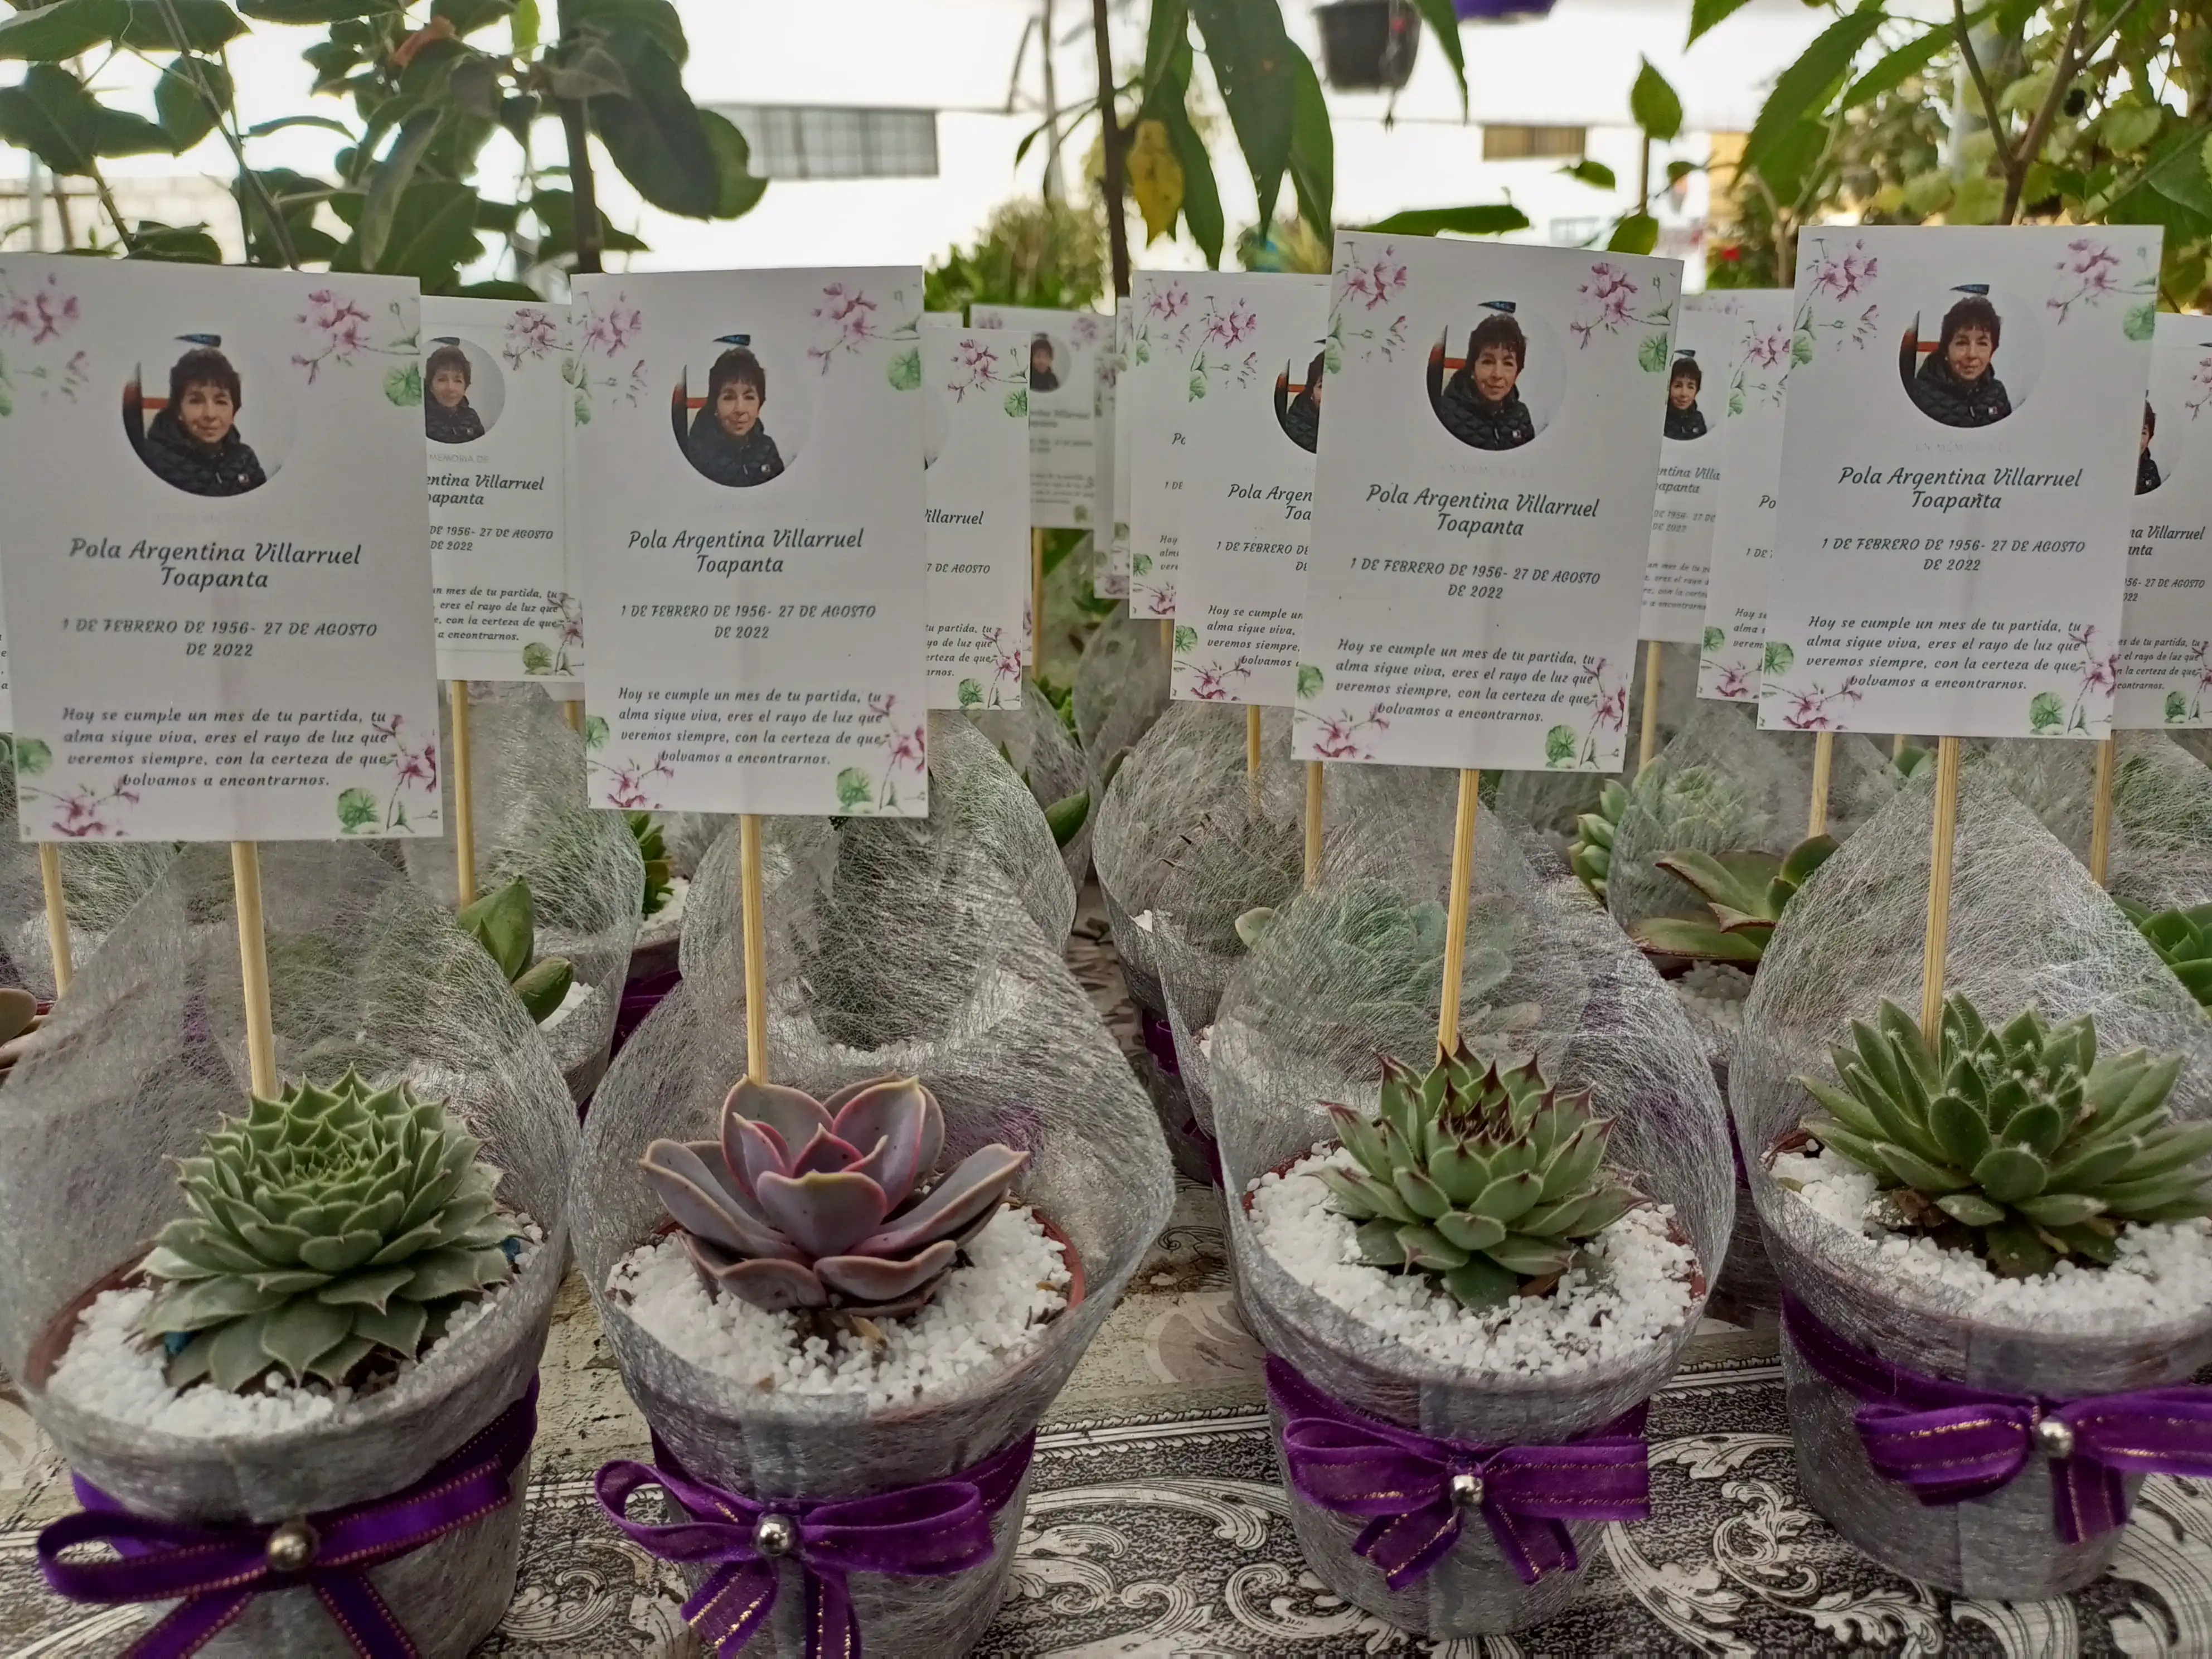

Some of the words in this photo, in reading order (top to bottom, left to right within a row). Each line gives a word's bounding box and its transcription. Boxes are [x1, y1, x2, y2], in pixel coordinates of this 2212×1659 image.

[476, 474, 545, 490] Villarruel
[1172, 481, 1183, 489] DE
[1838, 465, 1882, 484] Pola
[1886, 467, 1986, 490] Argentina
[1993, 467, 2083, 487] Villarruel
[1228, 483, 1262, 499] Pola
[1366, 484, 1409, 504] Pola
[1413, 488, 1509, 512] Argentina
[1516, 494, 1600, 517] Villarruel
[430, 526, 443, 535] DE
[479, 528, 493, 537] 27
[496, 528, 510, 537] DE
[512, 529, 554, 539] AGOSTO
[1437, 513, 1524, 538] Toapanta
[2148, 525, 2205, 540] Villarruel
[430, 541, 444, 549] DE
[446, 541, 473, 551] 2022
[628, 529, 667, 549] Pola
[672, 530, 765, 554] Argentina
[773, 527, 864, 547] Villarruel
[1160, 535, 1177, 545] Hoy
[1822, 538, 1828, 549] 1
[1833, 538, 1852, 550] DE
[1856, 538, 1920, 550] FEBRERO
[1925, 539, 1943, 551] DE
[1991, 540, 2007, 551] 27
[2011, 540, 2029, 552] DE
[2032, 541, 2085, 552] AGOSTO
[69, 537, 121, 558] Pola
[128, 540, 245, 566] Argentina
[255, 542, 362, 564] Villarruel
[1225, 542, 1240, 551] DE
[1243, 542, 1292, 554] FEBRERO
[1754, 549, 1768, 558] DE
[697, 555, 783, 579] Toapanta
[935, 563, 949, 573] DE
[951, 564, 990, 574] AGOSTO
[1351, 557, 1357, 569] 1
[1361, 558, 1380, 570] DE
[1384, 560, 1444, 574] FEBRERO
[1449, 564, 1468, 576] DE
[1513, 567, 1529, 580] 27
[1532, 569, 1549, 581] DE
[1551, 570, 1600, 584] AGOSTO
[1923, 559, 1942, 570] DE
[1947, 559, 1981, 571] 2022
[161, 566, 268, 593] Toapanta
[2145, 579, 2156, 587] 27
[2157, 579, 2170, 588] DE
[2171, 579, 2205, 588] AGOSTO
[1448, 584, 1466, 596] DE
[1470, 585, 1503, 599] 2022
[465, 601, 474, 609] el
[478, 604, 501, 613] rayo
[506, 602, 517, 611] de
[521, 603, 536, 612] luz
[540, 605, 558, 614] que
[622, 605, 626, 616] 1
[631, 605, 647, 617] DE
[652, 605, 709, 617] FEBRERO
[714, 605, 730, 617] DE
[778, 605, 794, 617] 27
[799, 605, 817, 618] DE
[821, 605, 876, 618] AGOSTO
[1208, 605, 1229, 618] Hoy
[1249, 608, 1287, 620] cumple
[1735, 608, 1755, 620] Hoy
[63, 618, 69, 629] 1
[76, 619, 98, 632] DE
[104, 619, 177, 633] FEBRERO
[185, 620, 205, 634] DE
[264, 622, 283, 634] 27
[289, 622, 309, 635] DE
[314, 623, 377, 637] AGOSTO
[715, 626, 731, 638] DE
[736, 627, 769, 638] 2022
[1734, 623, 1758, 633] alma
[1808, 615, 1836, 631] Hoy
[1861, 617, 1910, 632] cumple
[1971, 618, 1986, 630] de
[1992, 620, 2005, 630] tu
[2008, 619, 2061, 634] partida,
[2069, 622, 2081, 631] tu
[186, 642, 207, 656] DE
[213, 643, 253, 657] 2022
[1807, 635, 1841, 647] alma
[1846, 636, 1882, 651] sigue
[1888, 637, 1920, 649] viva,
[1962, 637, 1975, 649] el
[1978, 642, 2008, 653] rayo
[2014, 638, 2028, 650] de
[2034, 638, 2053, 651] luz
[2058, 642, 2080, 654] que
[1807, 658, 1864, 666] veremos
[1869, 656, 1927, 671] siempre,
[1964, 657, 1976, 669] la
[1982, 660, 2029, 670] certeza
[2034, 658, 2049, 670] de
[1935, 680, 2026, 689] encontrarnos.
[618, 687, 642, 703] Hoy
[648, 691, 659, 700] se
[665, 688, 709, 704] cumple
[715, 692, 729, 701] un
[735, 692, 760, 701] mes
[766, 688, 781, 701] de
[788, 692, 801, 701] tu
[805, 689, 860, 706] partida,
[868, 692, 881, 702] tu
[619, 707, 649, 720] alma
[654, 709, 686, 724] sigue
[691, 709, 721, 722] viva,
[727, 713, 753, 722] eres
[759, 710, 771, 722] el
[776, 714, 806, 726] rayo
[812, 710, 827, 722] de
[833, 710, 853, 723] luz
[858, 714, 882, 726] que
[621, 731, 671, 740] veremos
[677, 730, 729, 745] siempre,
[735, 734, 757, 743] con
[764, 730, 775, 743] la
[782, 734, 830, 743] certeza
[836, 731, 851, 744] de
[738, 754, 830, 764] encontrarnos.
